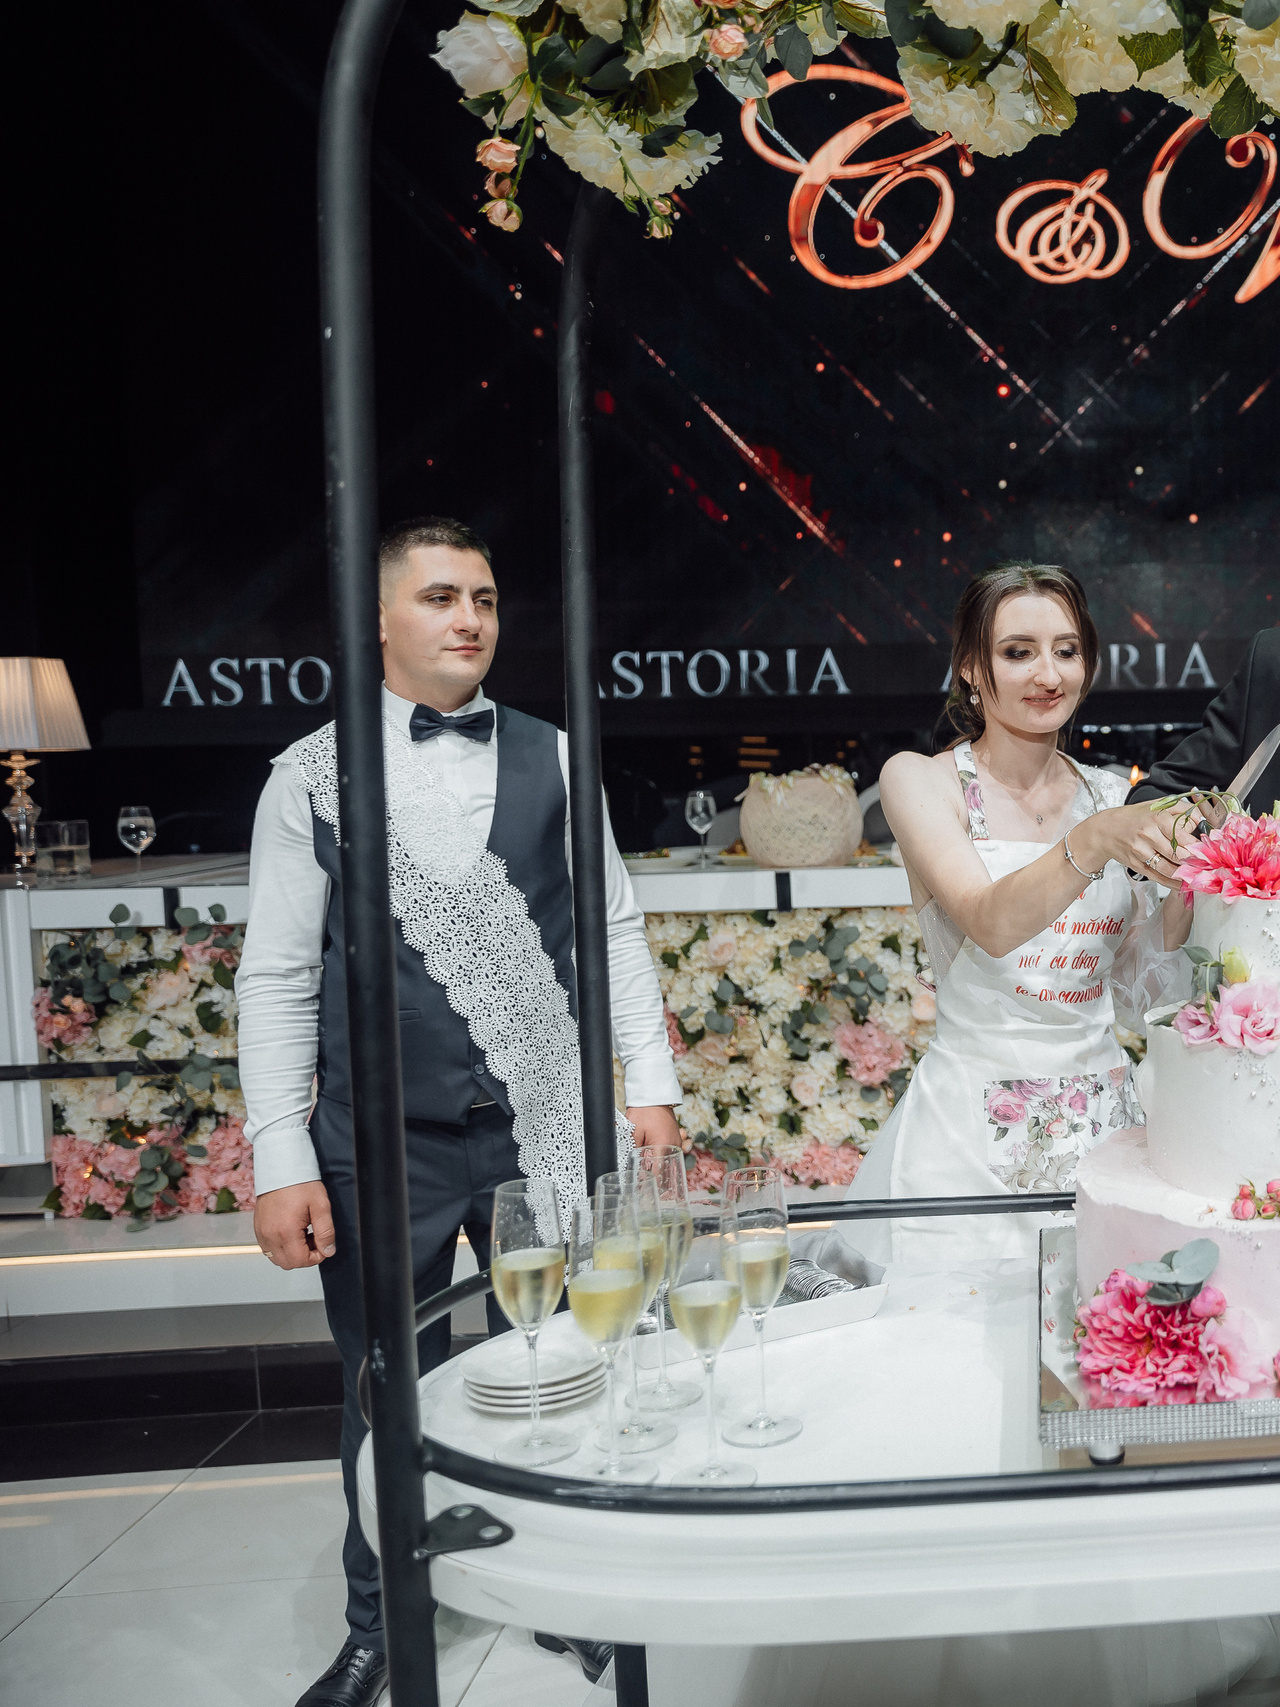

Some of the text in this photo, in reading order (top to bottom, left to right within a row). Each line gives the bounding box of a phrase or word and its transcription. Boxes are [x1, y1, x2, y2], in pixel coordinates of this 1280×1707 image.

[161, 655, 333, 706] ASTO
[598, 647, 851, 699] STORIA
[1018, 948, 1100, 978] noi cu drag
